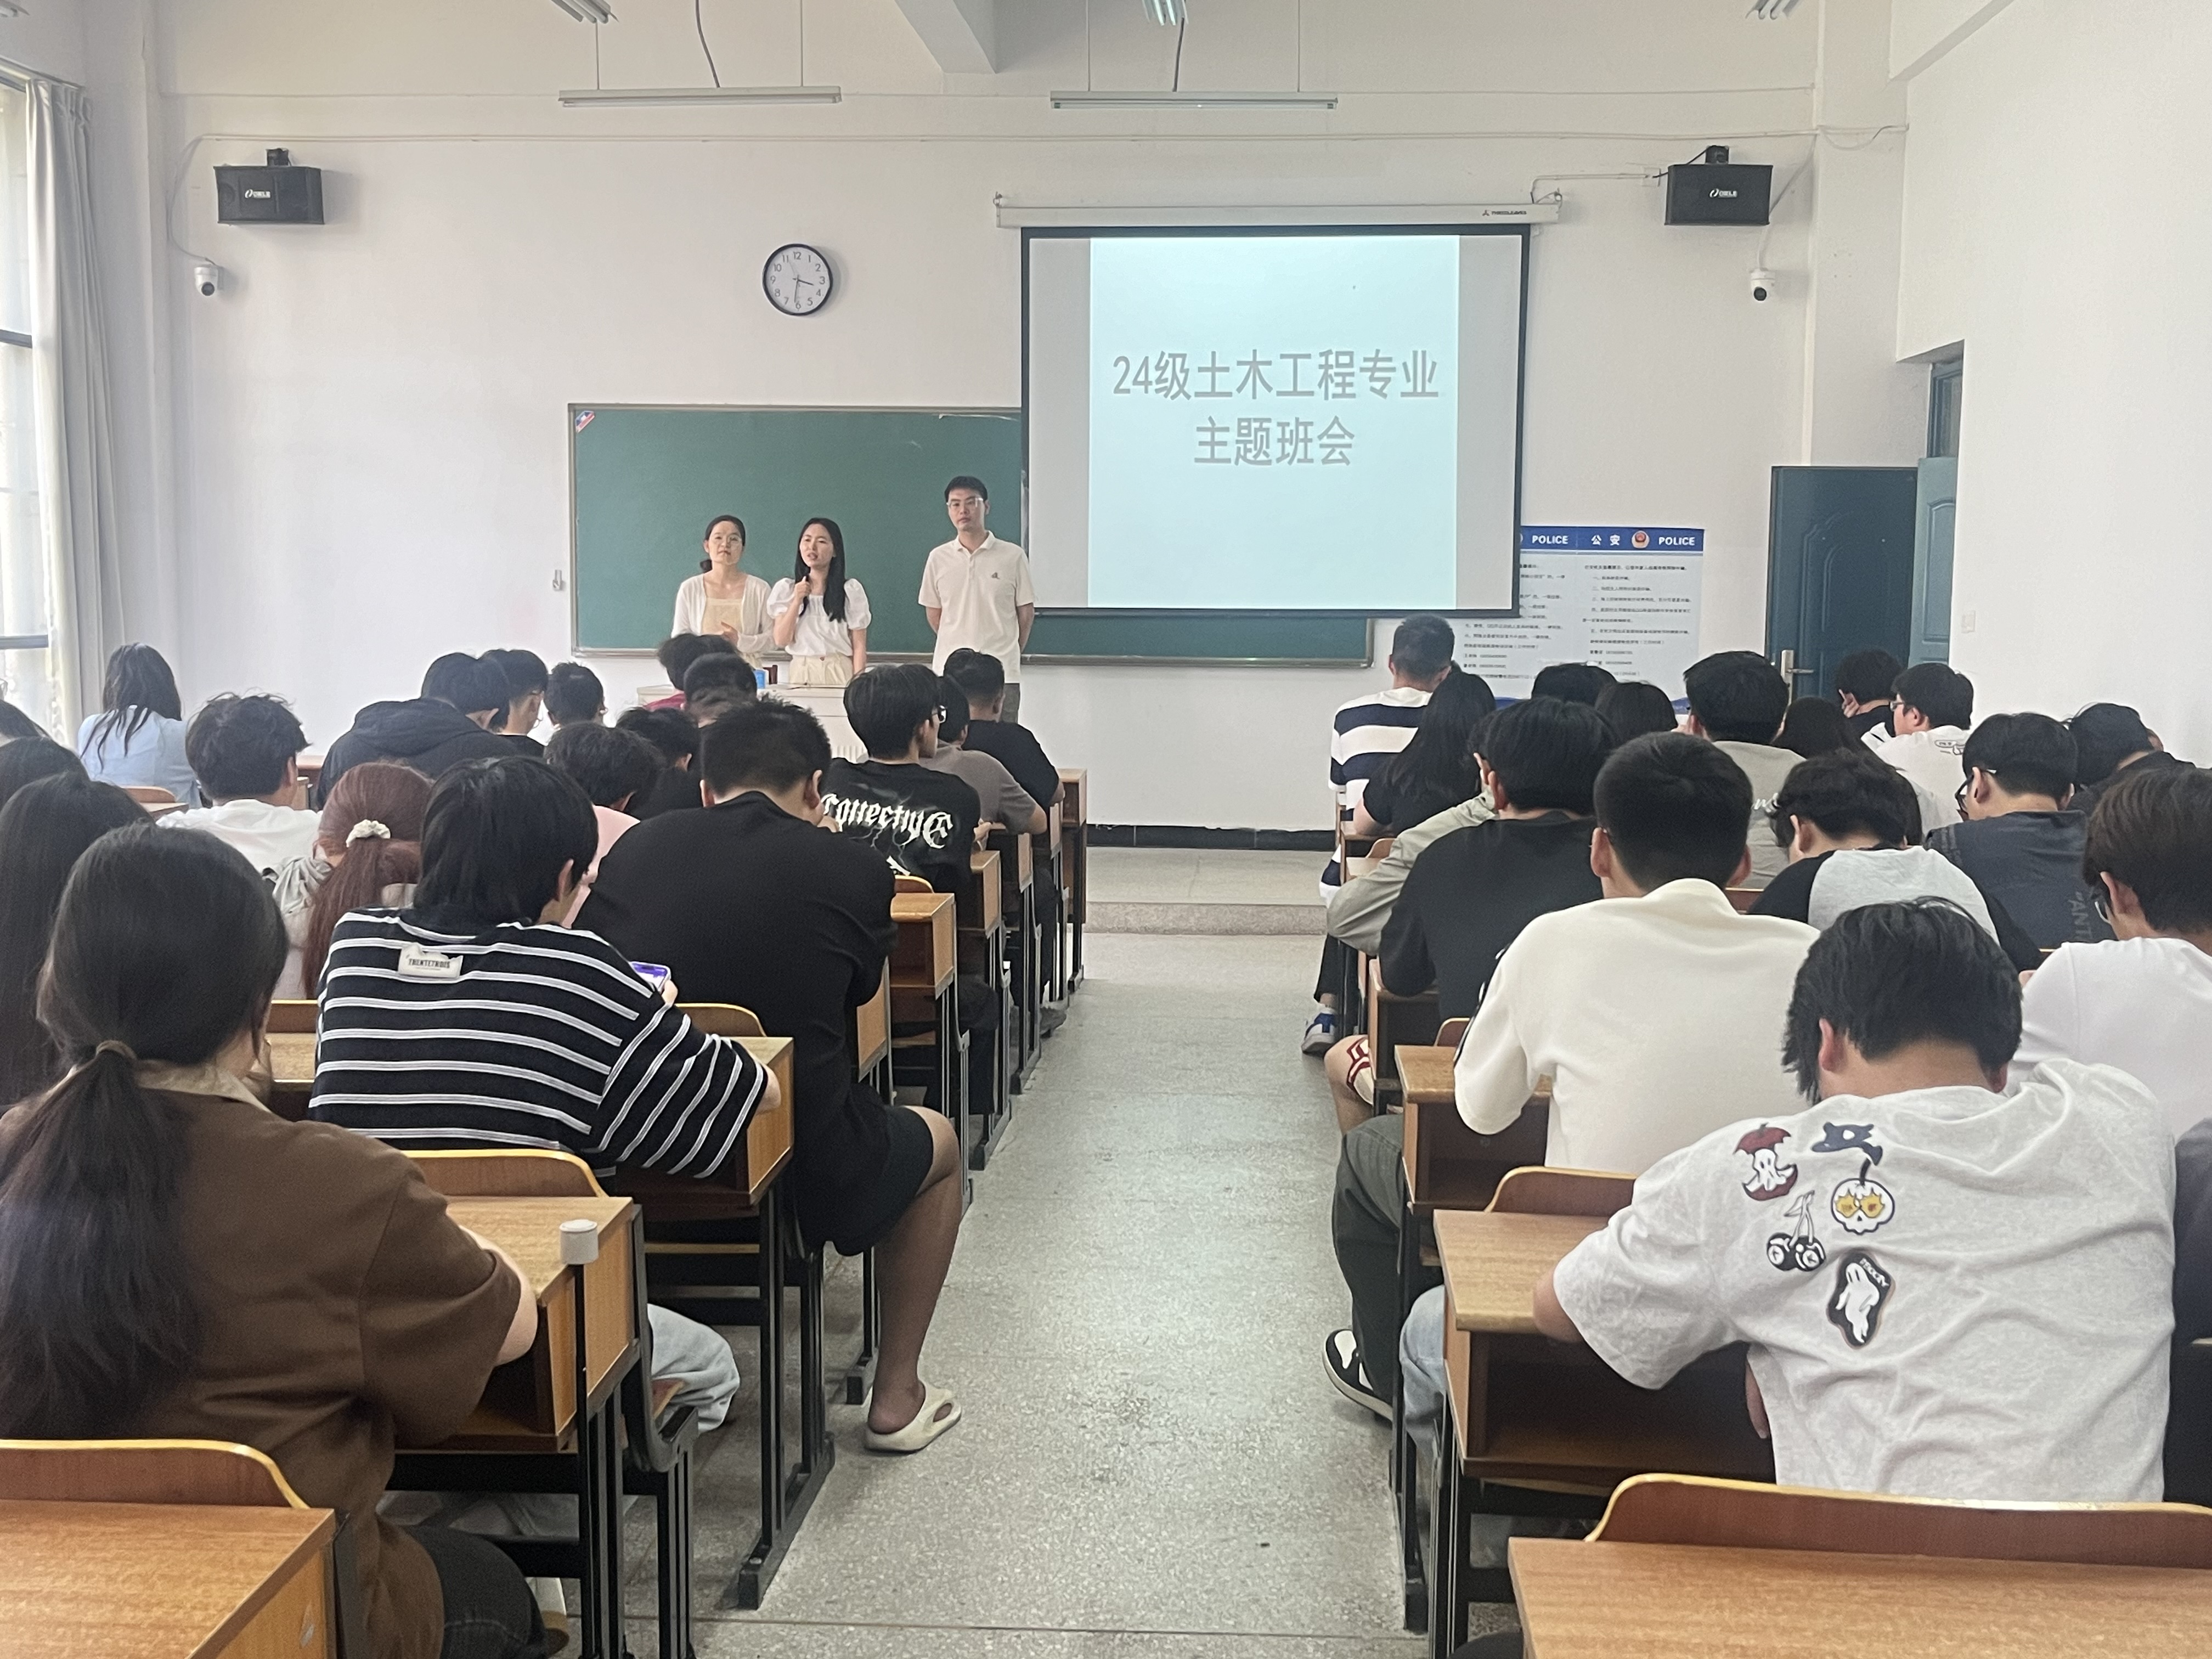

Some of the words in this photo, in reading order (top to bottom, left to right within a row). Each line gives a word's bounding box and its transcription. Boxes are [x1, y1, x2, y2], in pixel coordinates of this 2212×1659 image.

[782, 255, 789, 263] 11
[793, 251, 802, 260] 12
[774, 263, 782, 272] 10
[815, 263, 821, 272] 2
[770, 275, 776, 284] 9
[819, 276, 826, 285] 3
[775, 289, 781, 297] 8
[784, 297, 789, 305] 7
[795, 301, 802, 309] 6
[807, 297, 813, 306] 5
[1113, 349, 1439, 400] 24级土木工程专业
[1194, 415, 1356, 466] 主题班会
[1532, 535, 1569, 545] POLICE
[1658, 536, 1695, 546] POLICE
